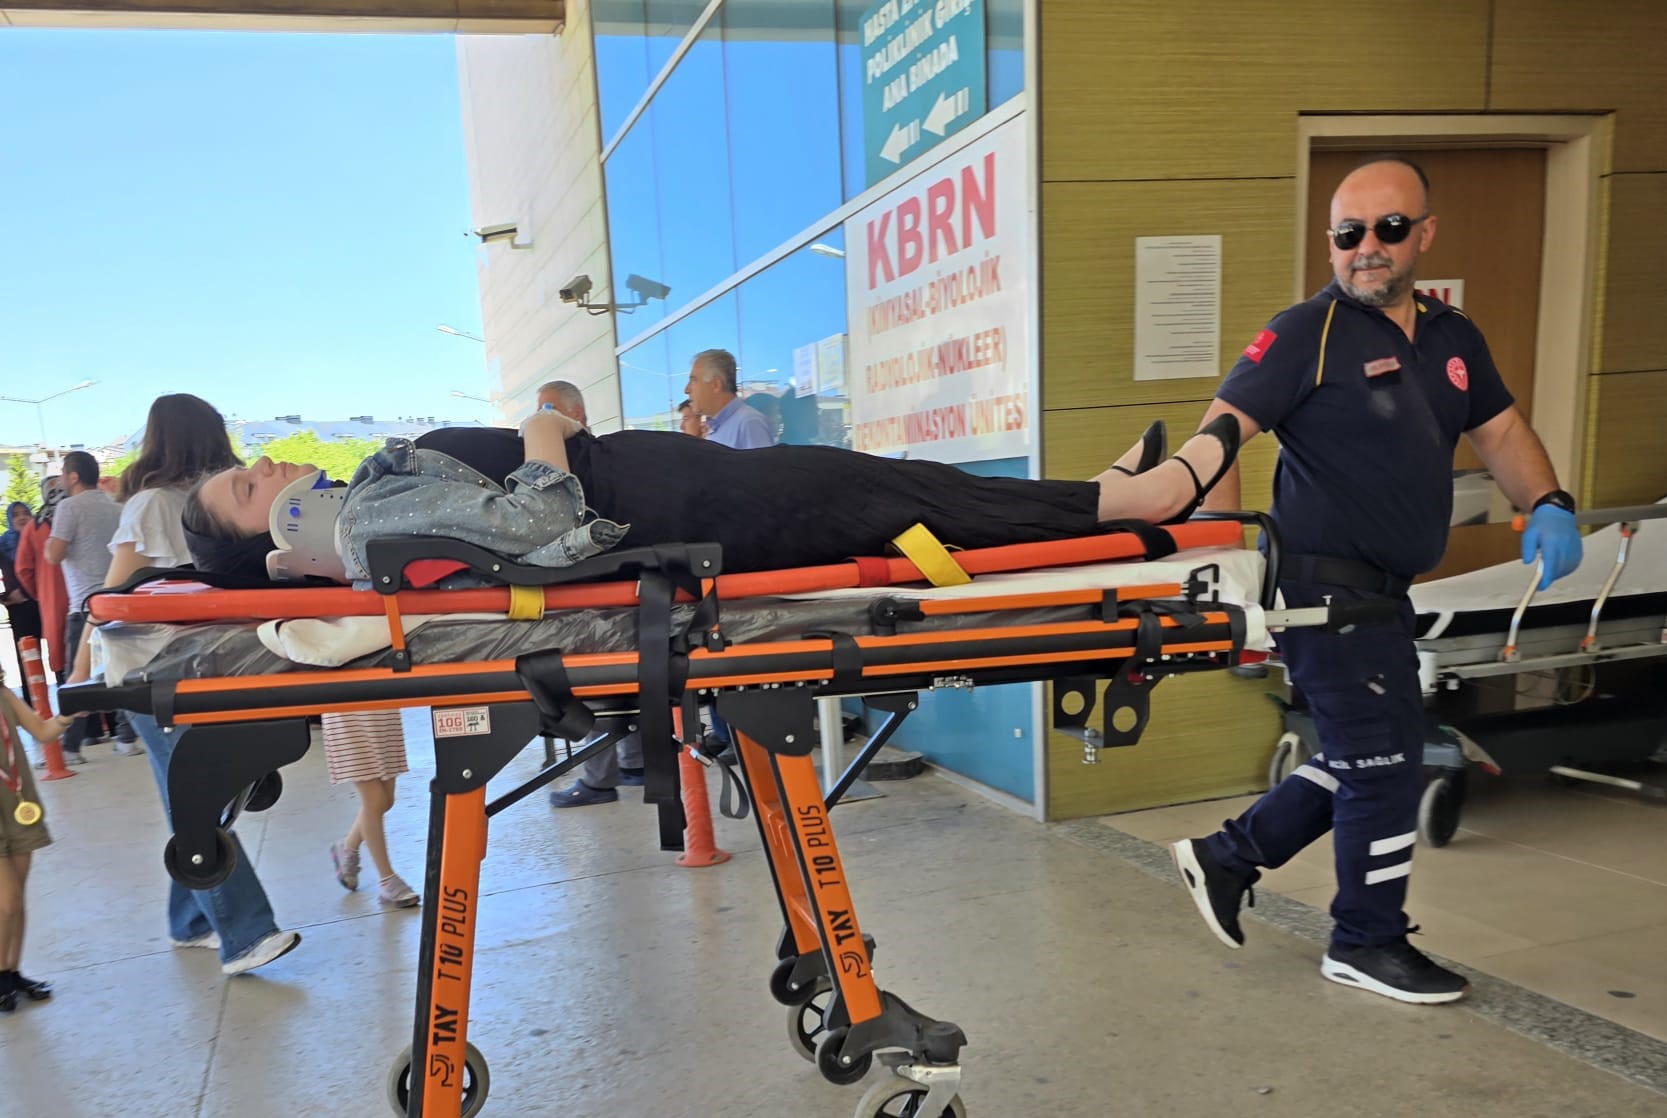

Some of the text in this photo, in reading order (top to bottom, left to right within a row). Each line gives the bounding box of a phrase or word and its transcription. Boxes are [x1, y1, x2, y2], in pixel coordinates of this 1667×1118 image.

[866, 151, 996, 291] KBRN
[798, 804, 829, 848] PLUS
[441, 885, 468, 938] PLUS
[827, 909, 855, 946] TAY
[432, 1004, 459, 1045] TAY
